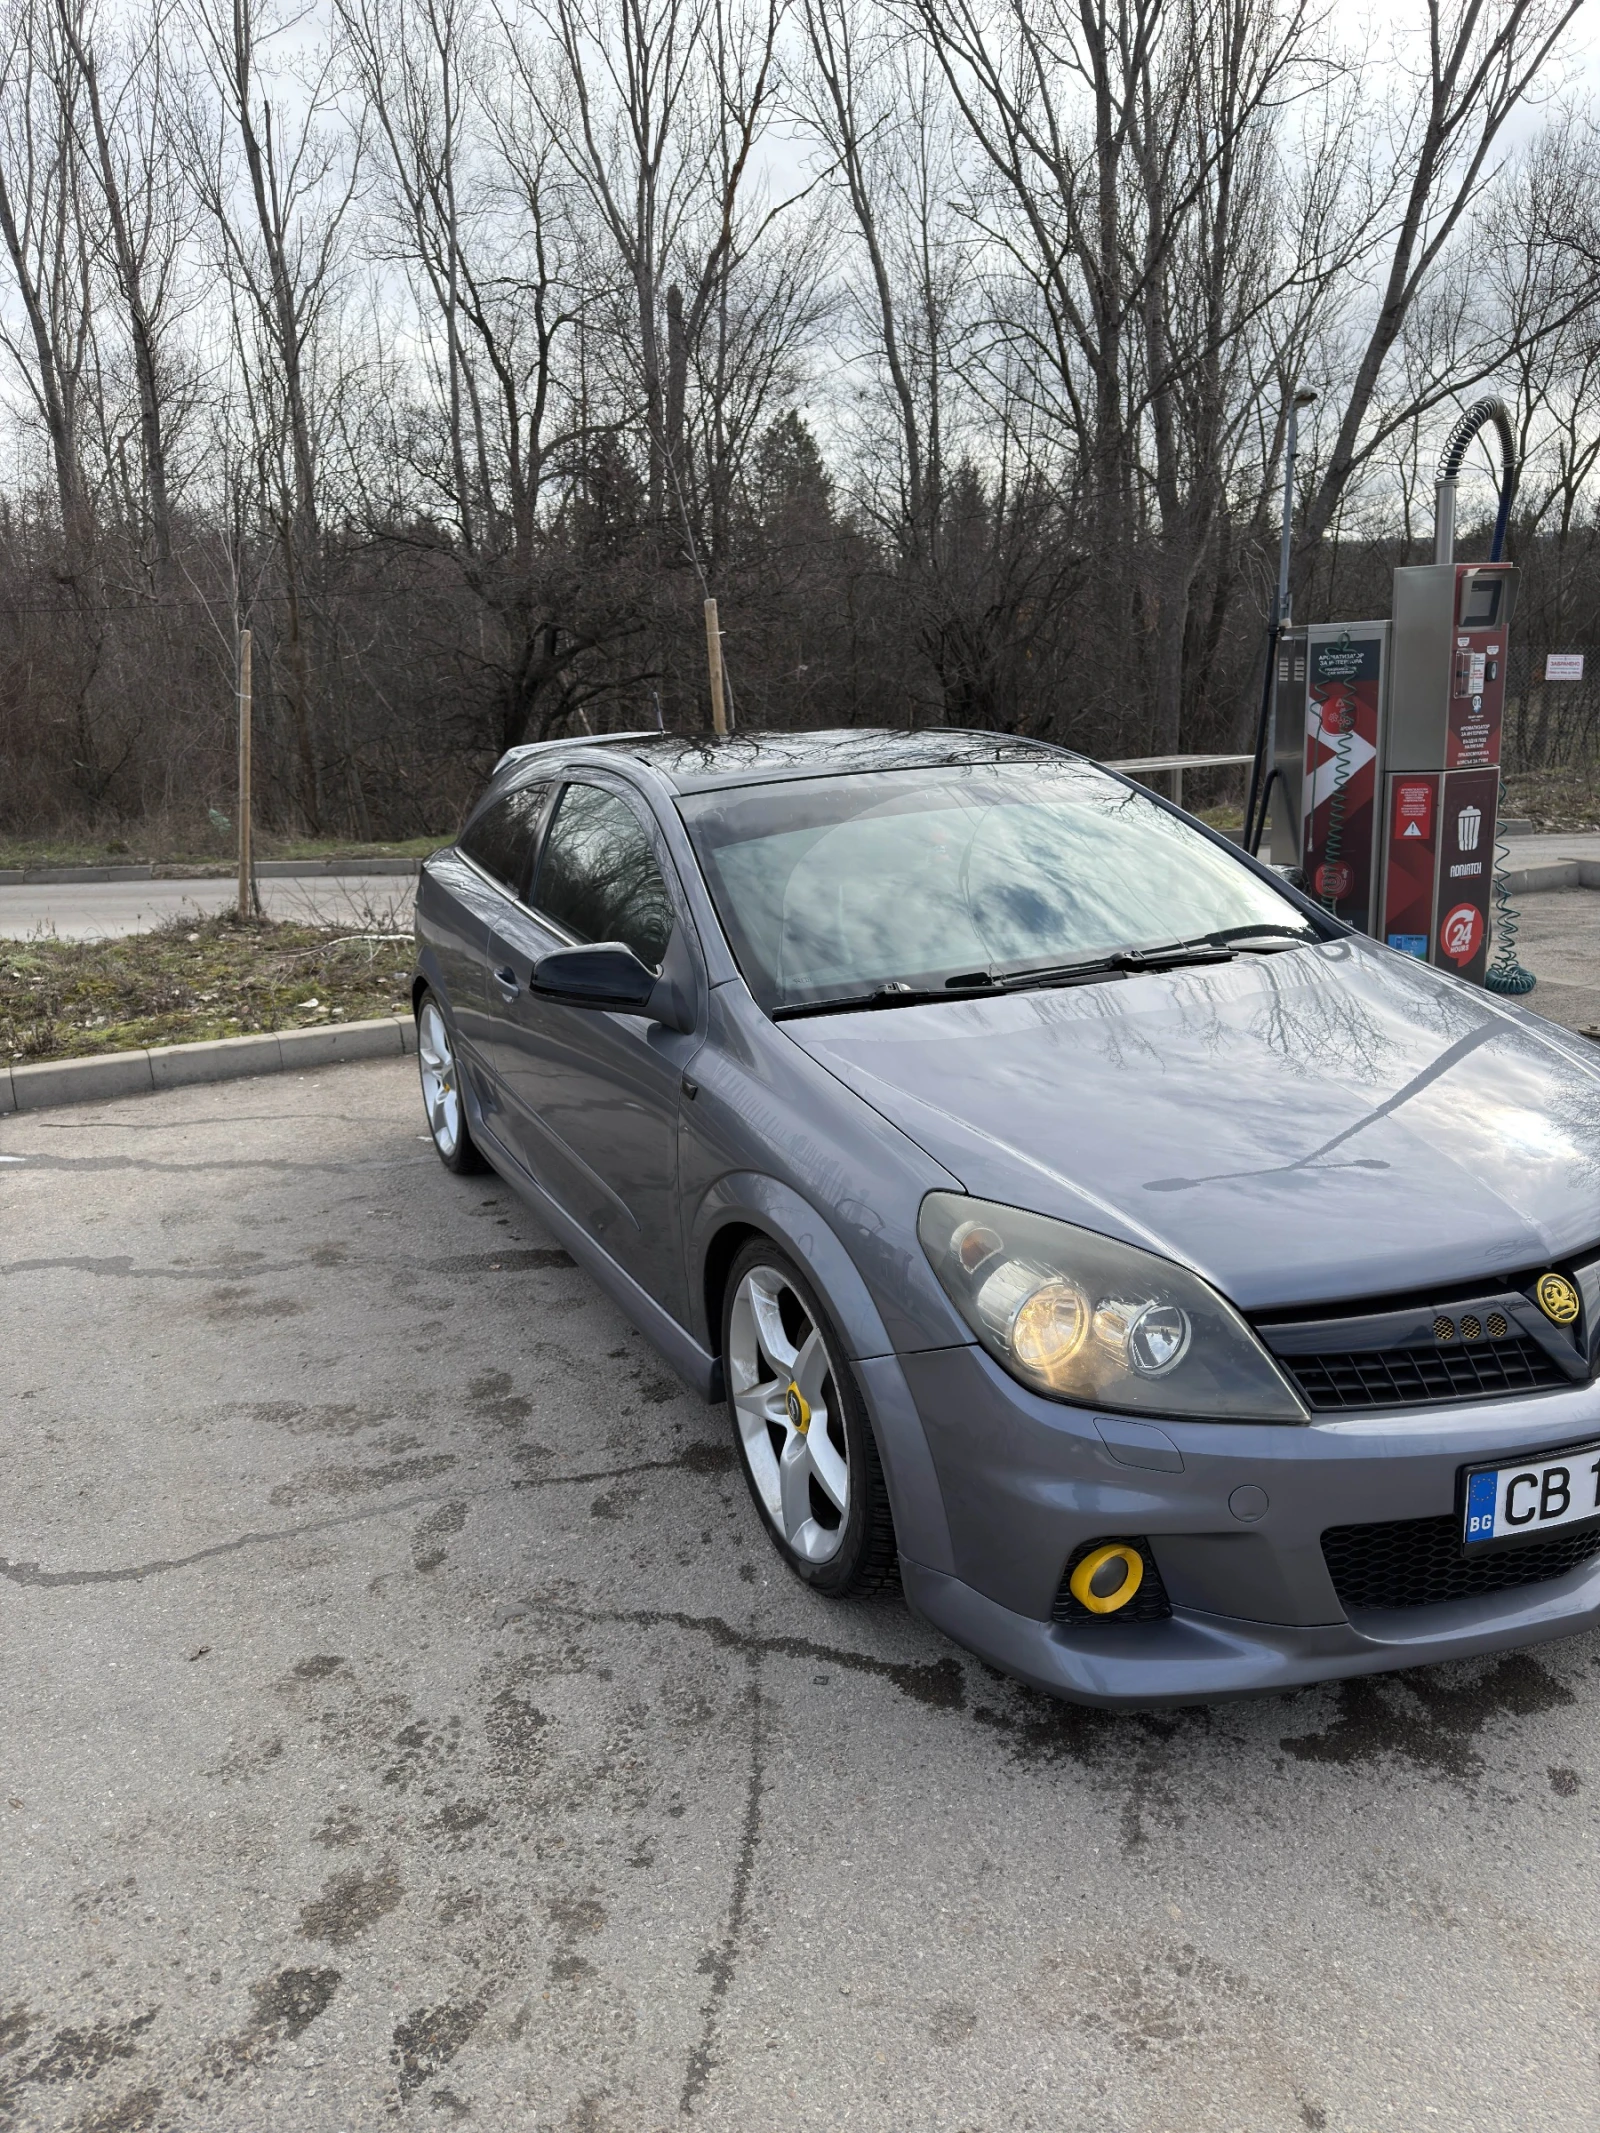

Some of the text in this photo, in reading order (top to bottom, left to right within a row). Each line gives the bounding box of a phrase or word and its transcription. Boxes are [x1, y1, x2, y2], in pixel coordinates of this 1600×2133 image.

[1452, 922, 1472, 946] 24
[1450, 945, 1469, 953] HOURS
[1504, 1466, 1571, 1526] CB
[1469, 1514, 1493, 1533] BG
